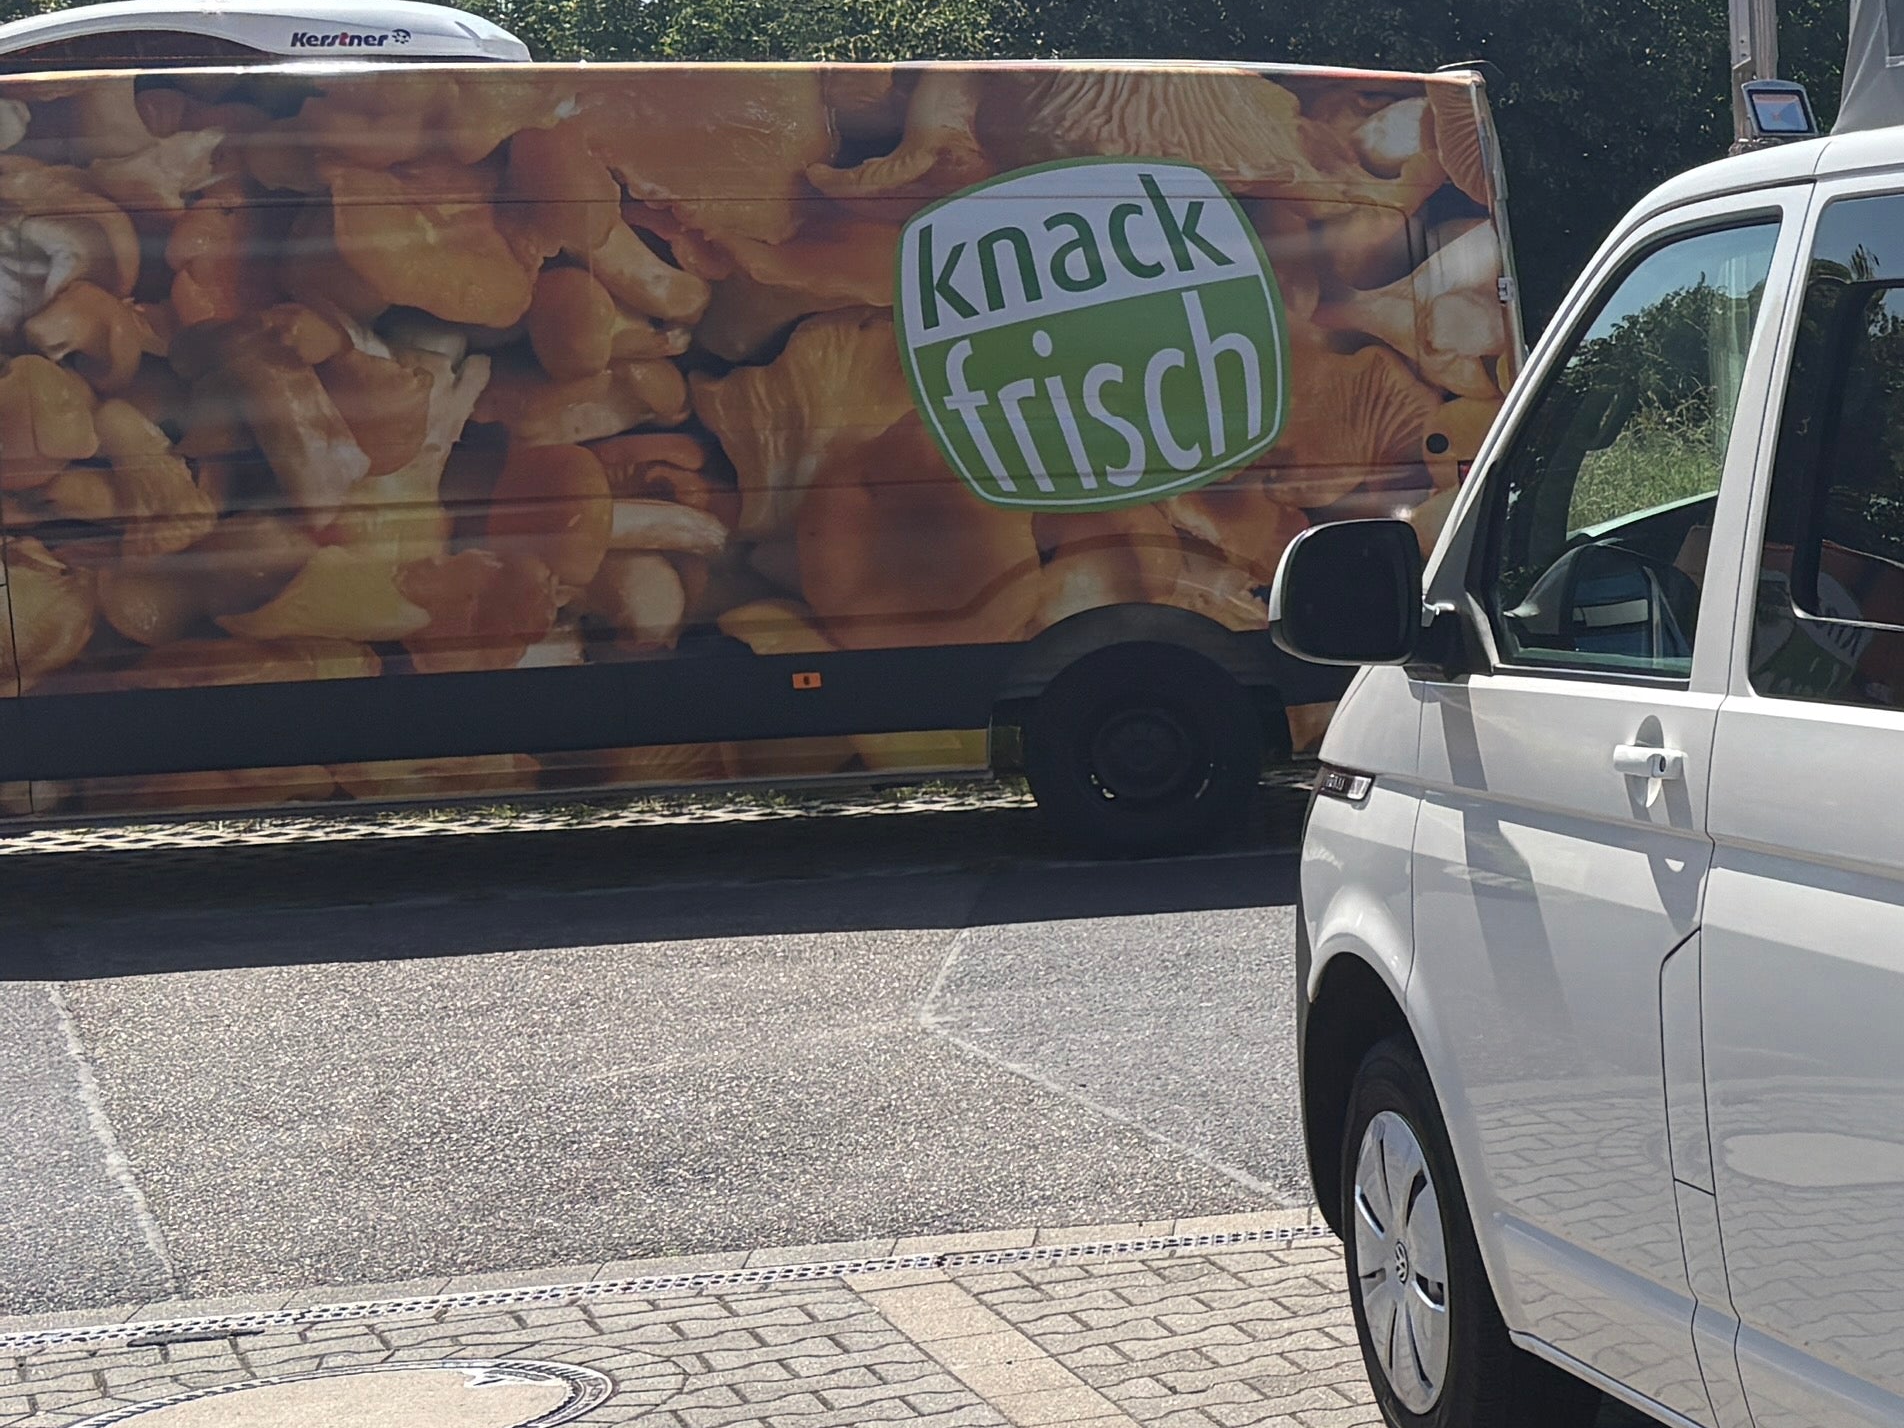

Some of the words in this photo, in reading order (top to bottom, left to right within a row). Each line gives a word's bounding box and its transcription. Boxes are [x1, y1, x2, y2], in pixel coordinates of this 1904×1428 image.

[290, 32, 389, 47] Kerstner
[918, 173, 1236, 329] knack
[943, 291, 1263, 493] frisch
